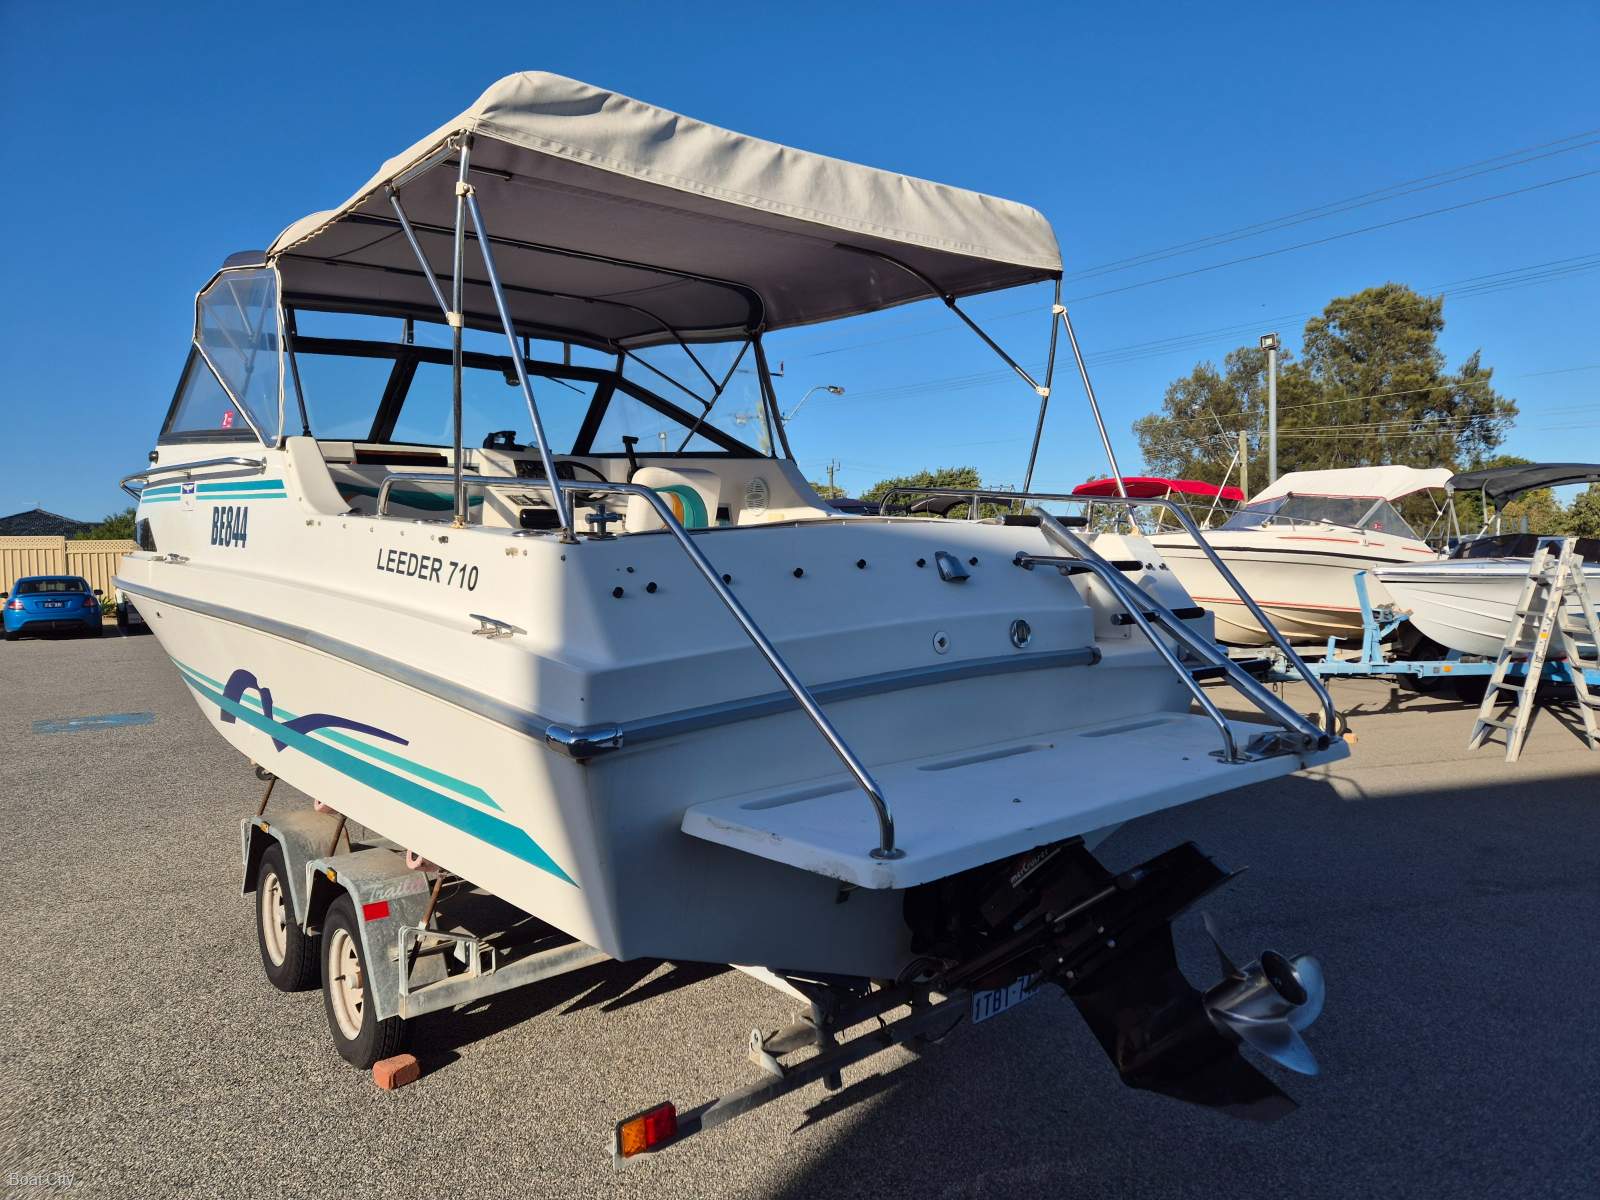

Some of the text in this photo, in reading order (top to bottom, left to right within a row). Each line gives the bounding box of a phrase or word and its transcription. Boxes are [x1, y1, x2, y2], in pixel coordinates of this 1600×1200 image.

[210, 505, 249, 549] BE844
[376, 547, 479, 592] LEEDER 710
